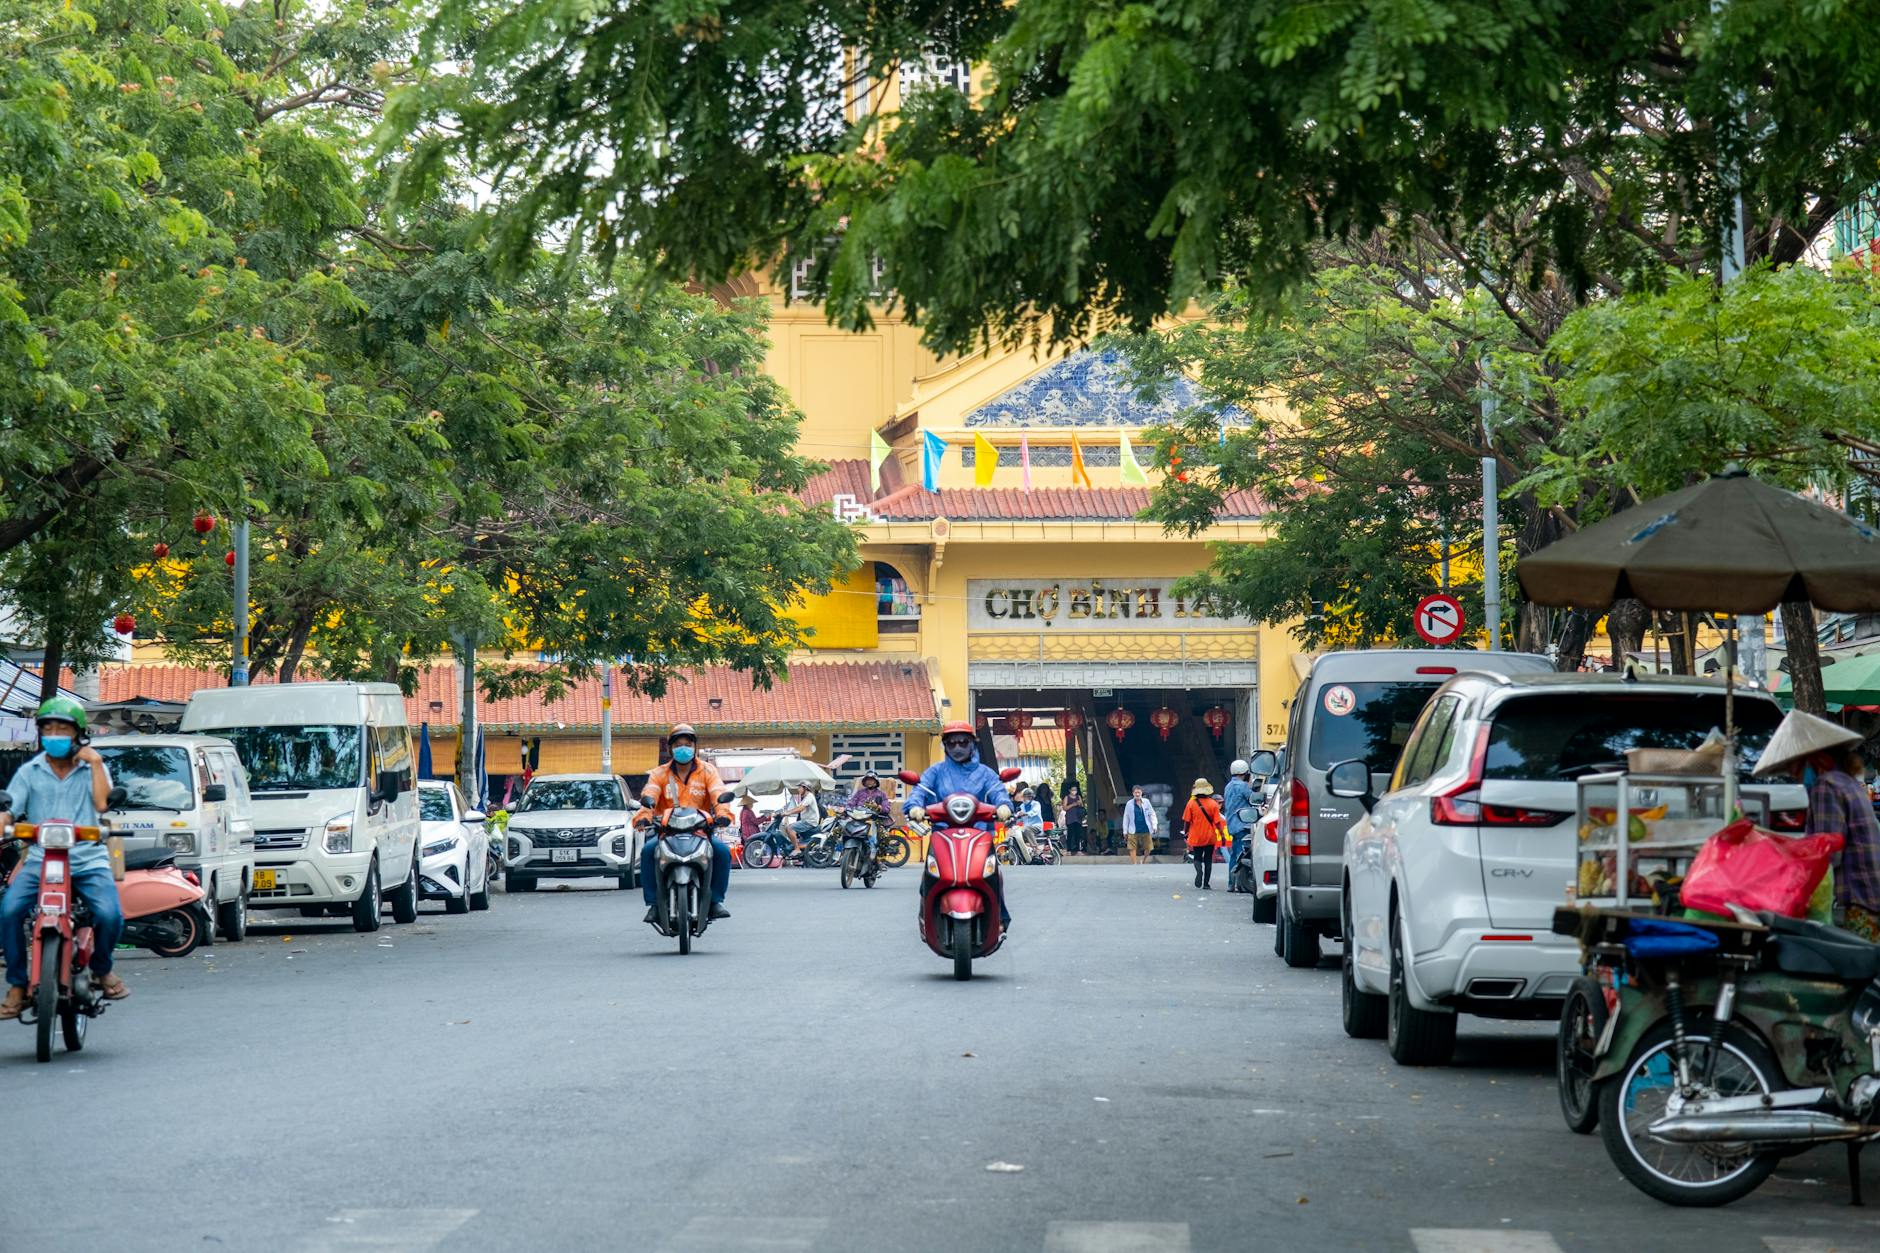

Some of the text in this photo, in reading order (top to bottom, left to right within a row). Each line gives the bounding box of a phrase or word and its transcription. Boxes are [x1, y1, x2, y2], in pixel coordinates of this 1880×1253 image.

[984, 583, 1060, 627] CHỢ
[1067, 578, 1163, 619] BÌNH
[1266, 724, 1287, 736] 57A
[1491, 868, 1534, 878] CR-V
